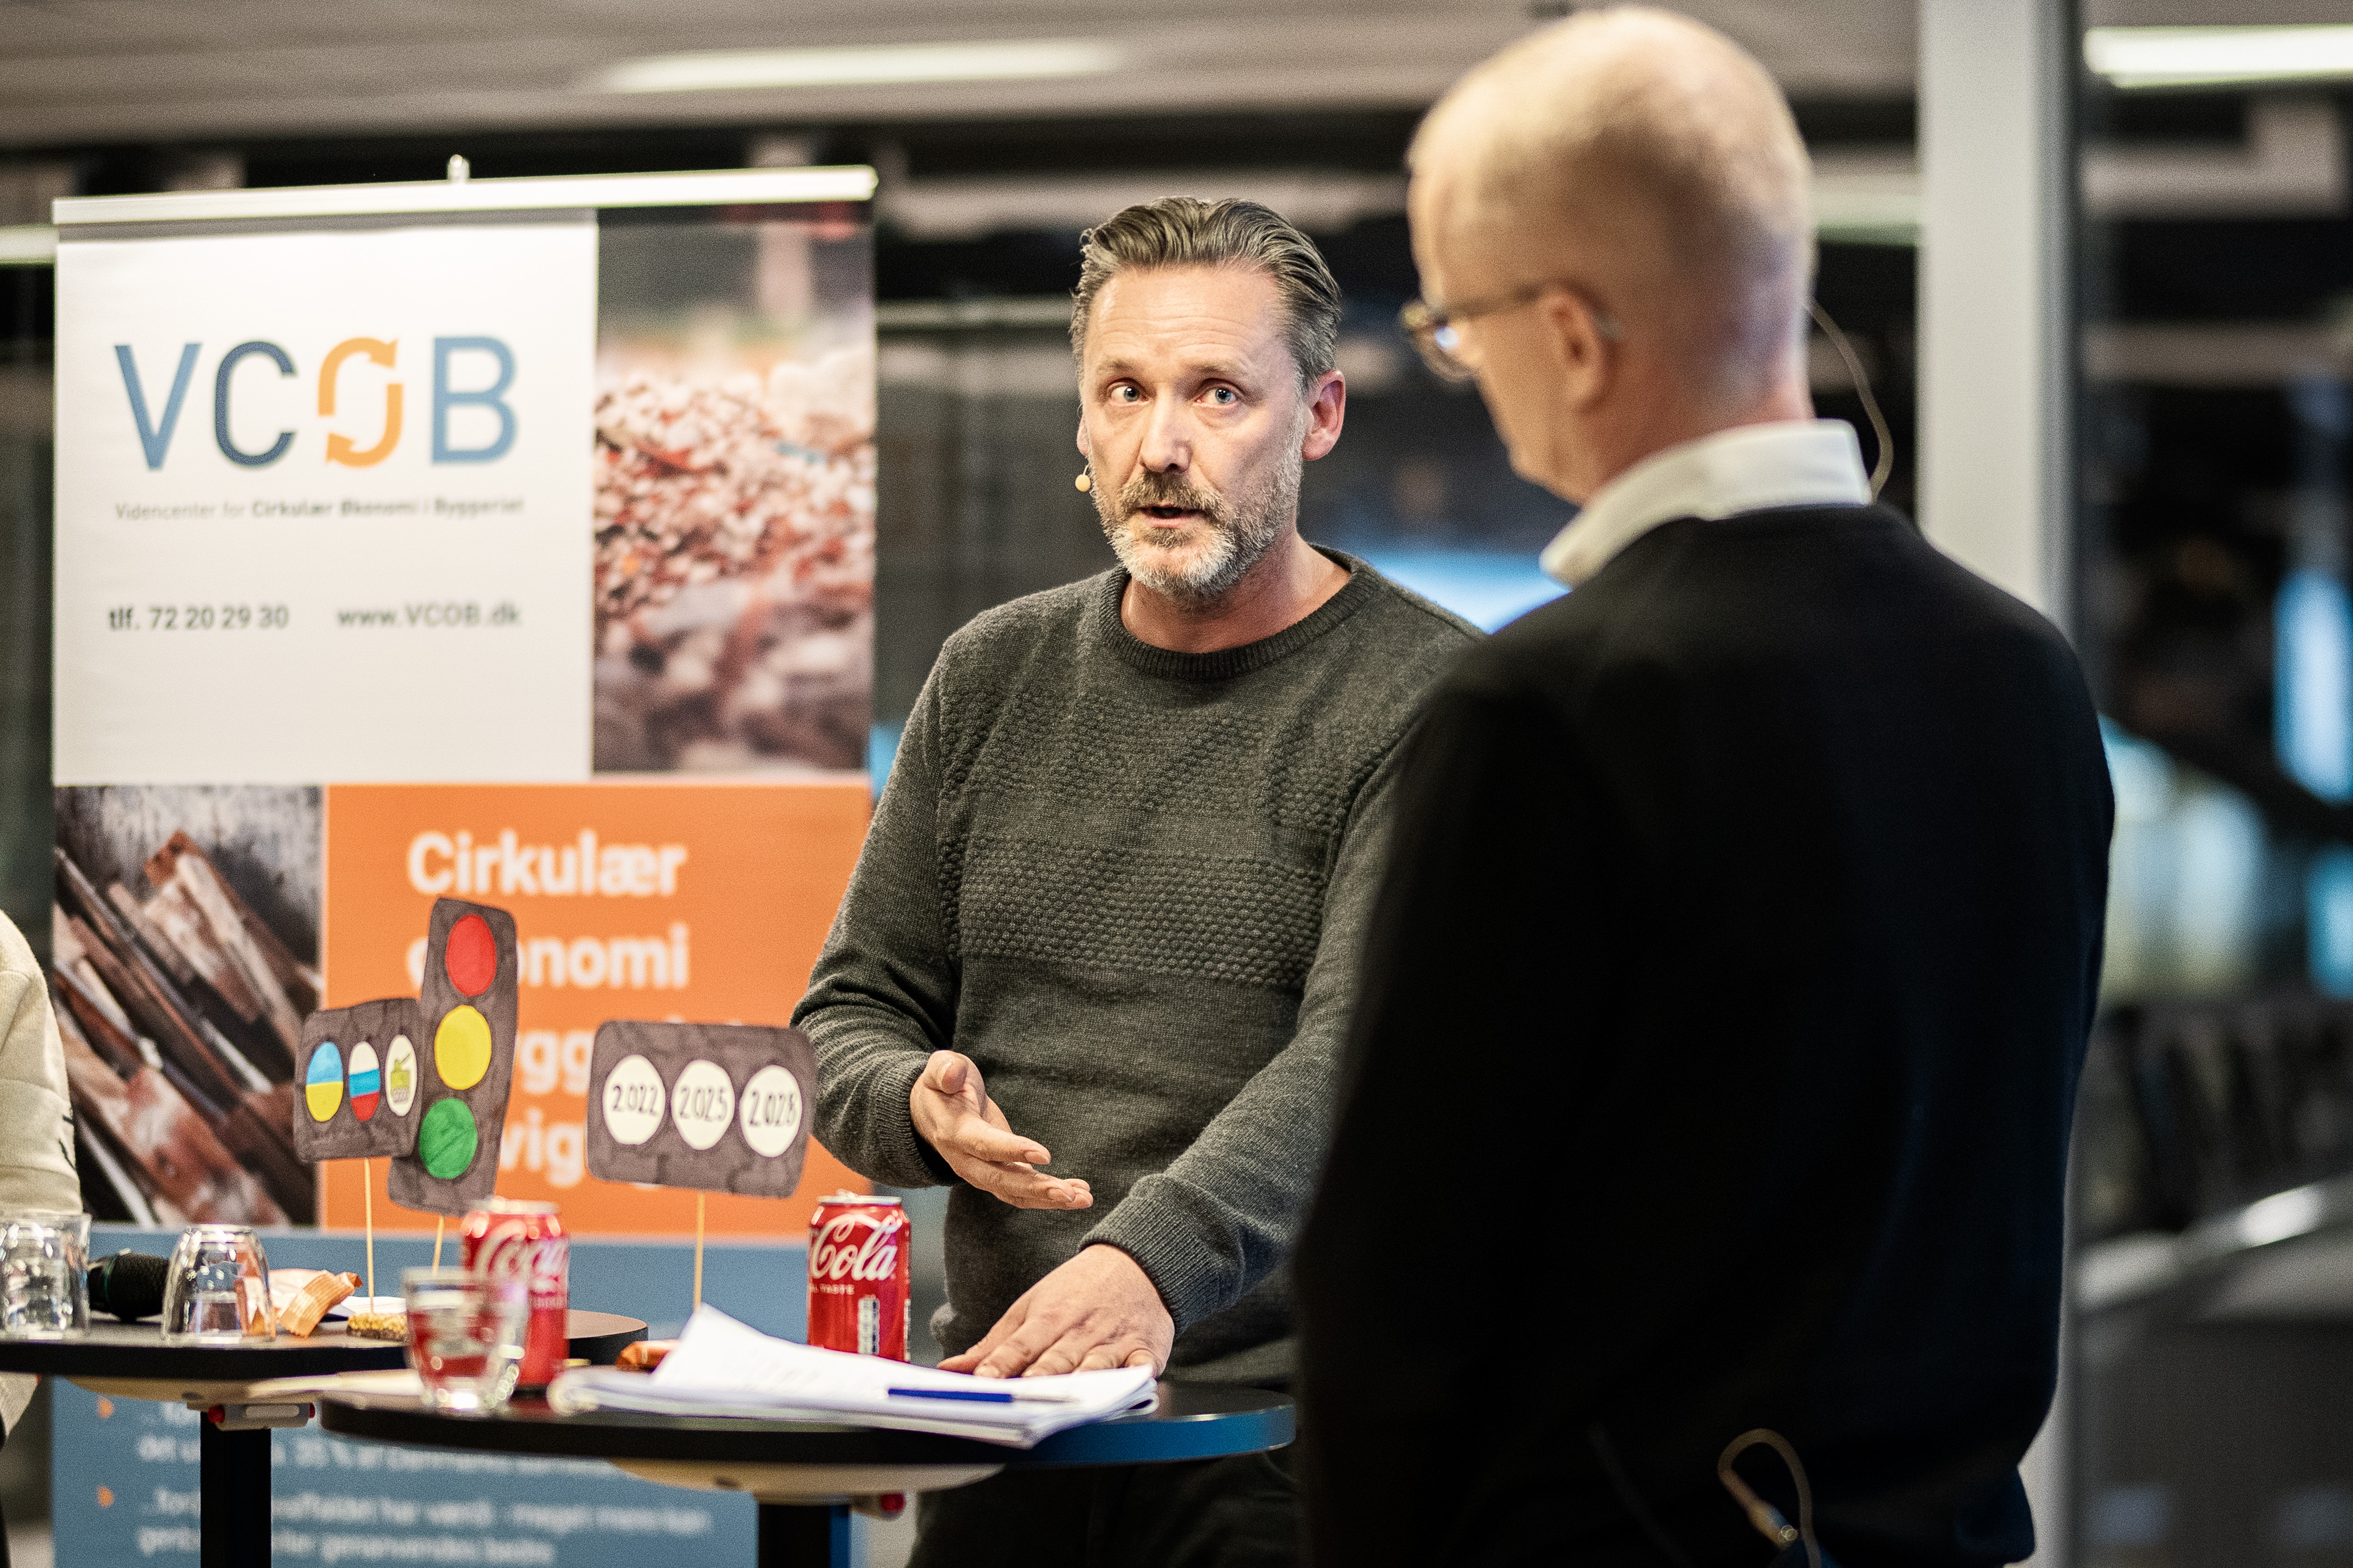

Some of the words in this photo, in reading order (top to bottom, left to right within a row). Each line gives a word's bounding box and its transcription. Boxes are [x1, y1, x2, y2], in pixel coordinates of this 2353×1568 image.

[114, 335, 517, 471] VCOB
[109, 605, 140, 630] tlf.
[150, 607, 177, 629] 72
[185, 607, 215, 629] 20
[221, 606, 251, 629] 29
[259, 606, 289, 629] 30
[337, 601, 521, 628] www.VCOB.dk
[408, 830, 687, 896] Cirkulær
[612, 1084, 658, 1118] 2022
[679, 1086, 728, 1122] 2025
[810, 1213, 898, 1281] Cola
